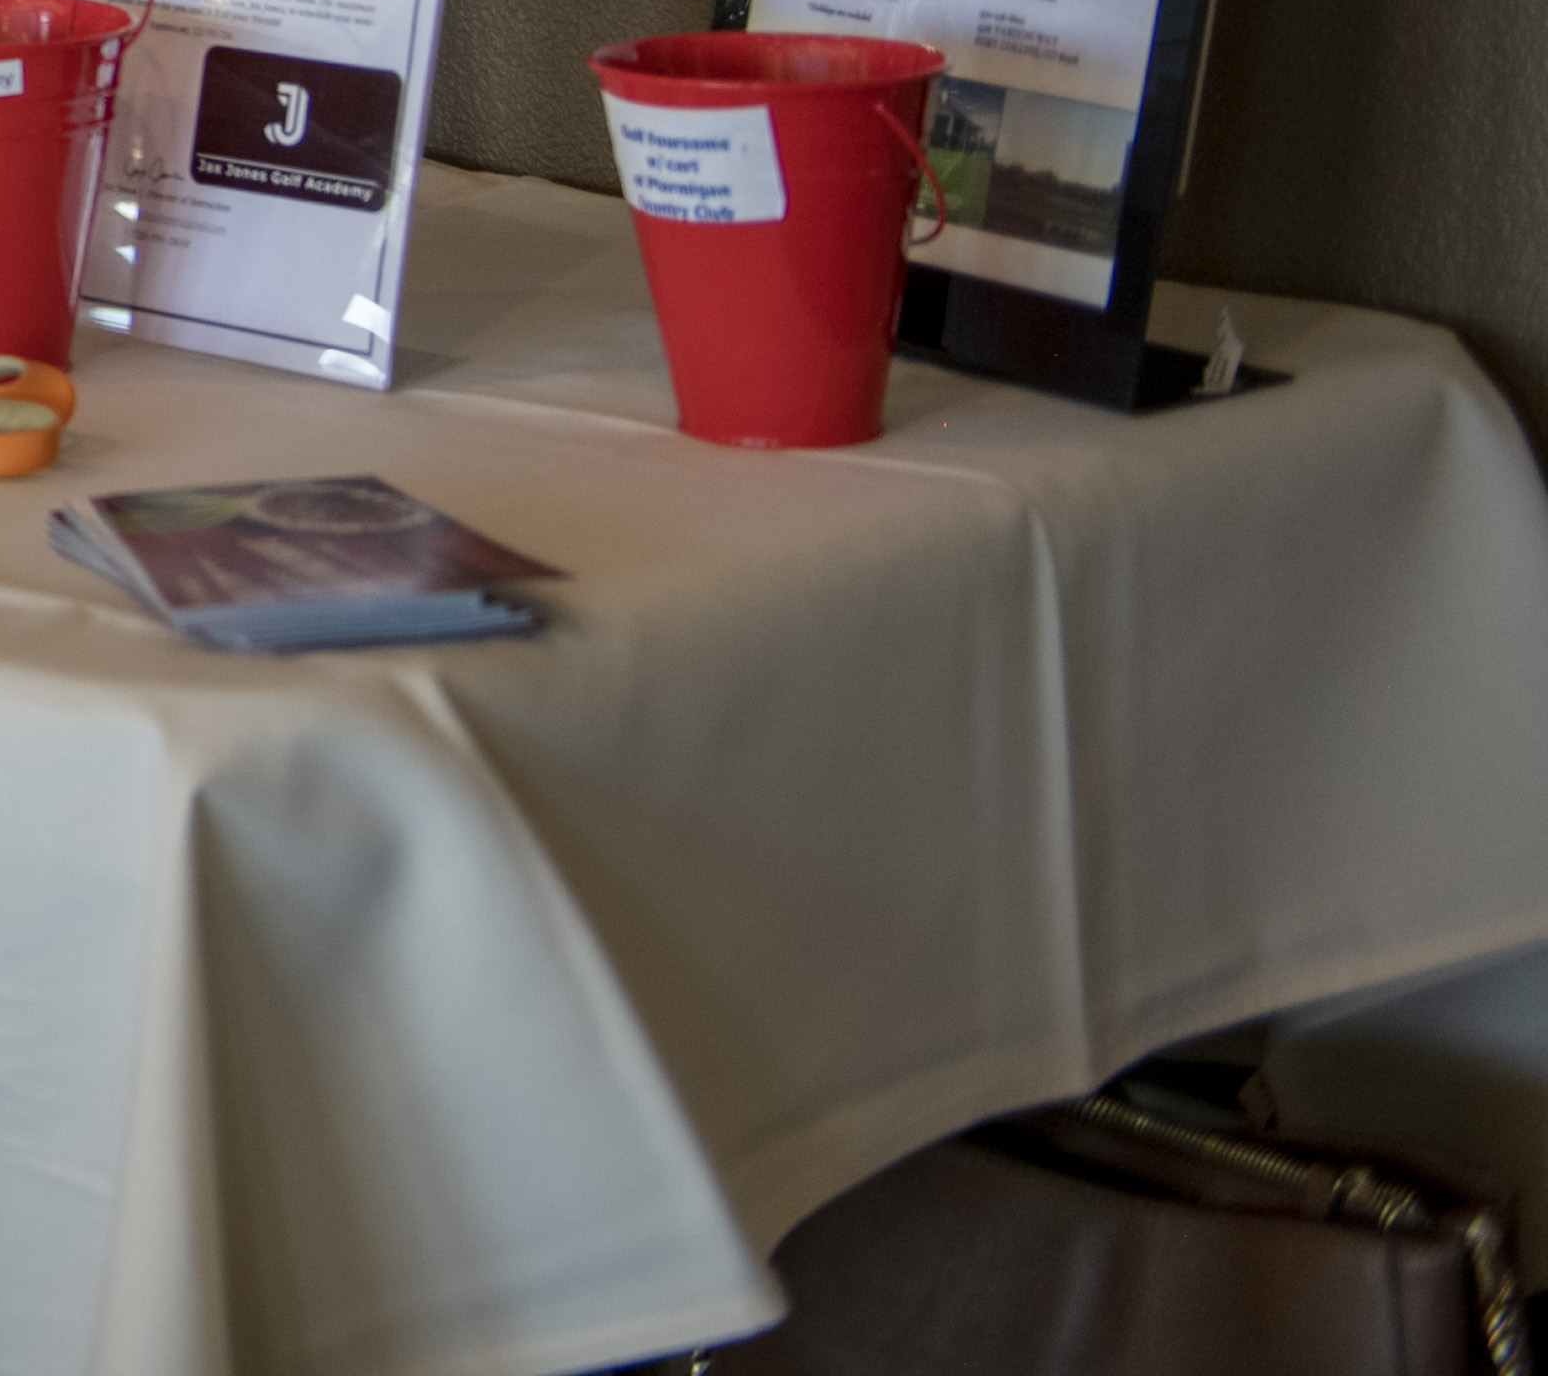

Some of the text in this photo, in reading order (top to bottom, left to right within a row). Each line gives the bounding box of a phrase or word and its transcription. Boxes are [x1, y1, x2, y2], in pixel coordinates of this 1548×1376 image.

[197, 159, 374, 203] Jax Jones Golf Academy
